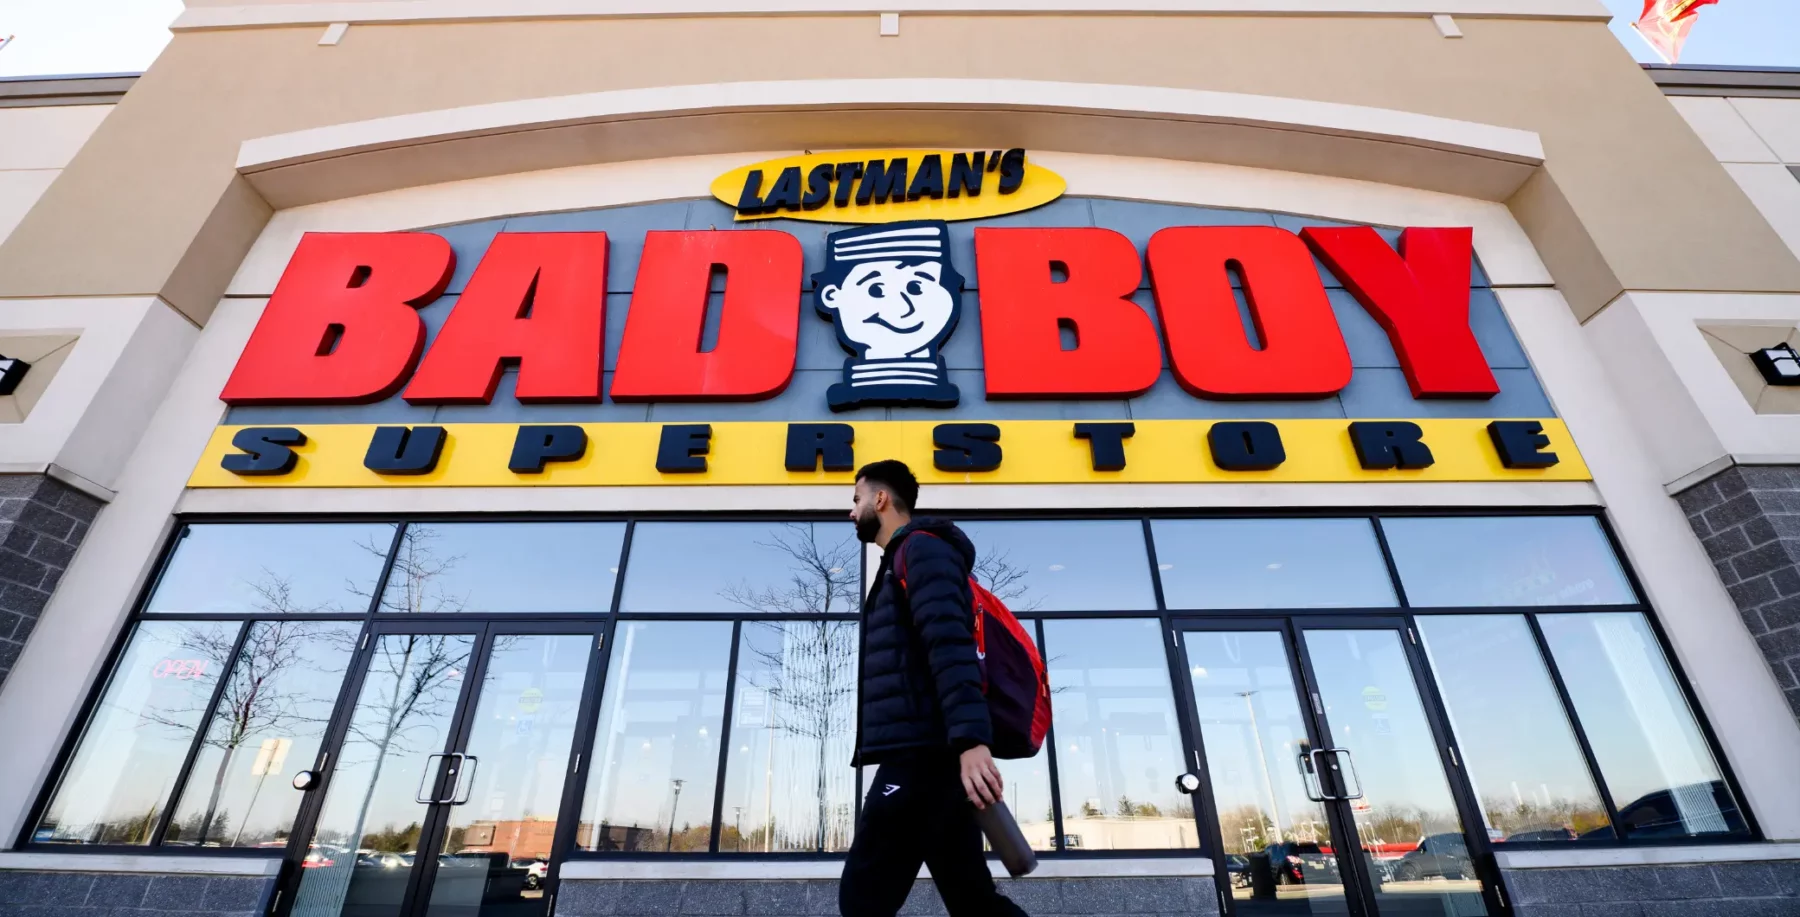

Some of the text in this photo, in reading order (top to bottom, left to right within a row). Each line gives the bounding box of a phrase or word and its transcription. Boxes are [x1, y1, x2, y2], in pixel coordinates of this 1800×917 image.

[738, 147, 1026, 215] LASTMAN'S
[219, 225, 1500, 405] BAD BOY
[220, 420, 1560, 475] SUPERSTORE
[153, 659, 209, 679] OPEN
